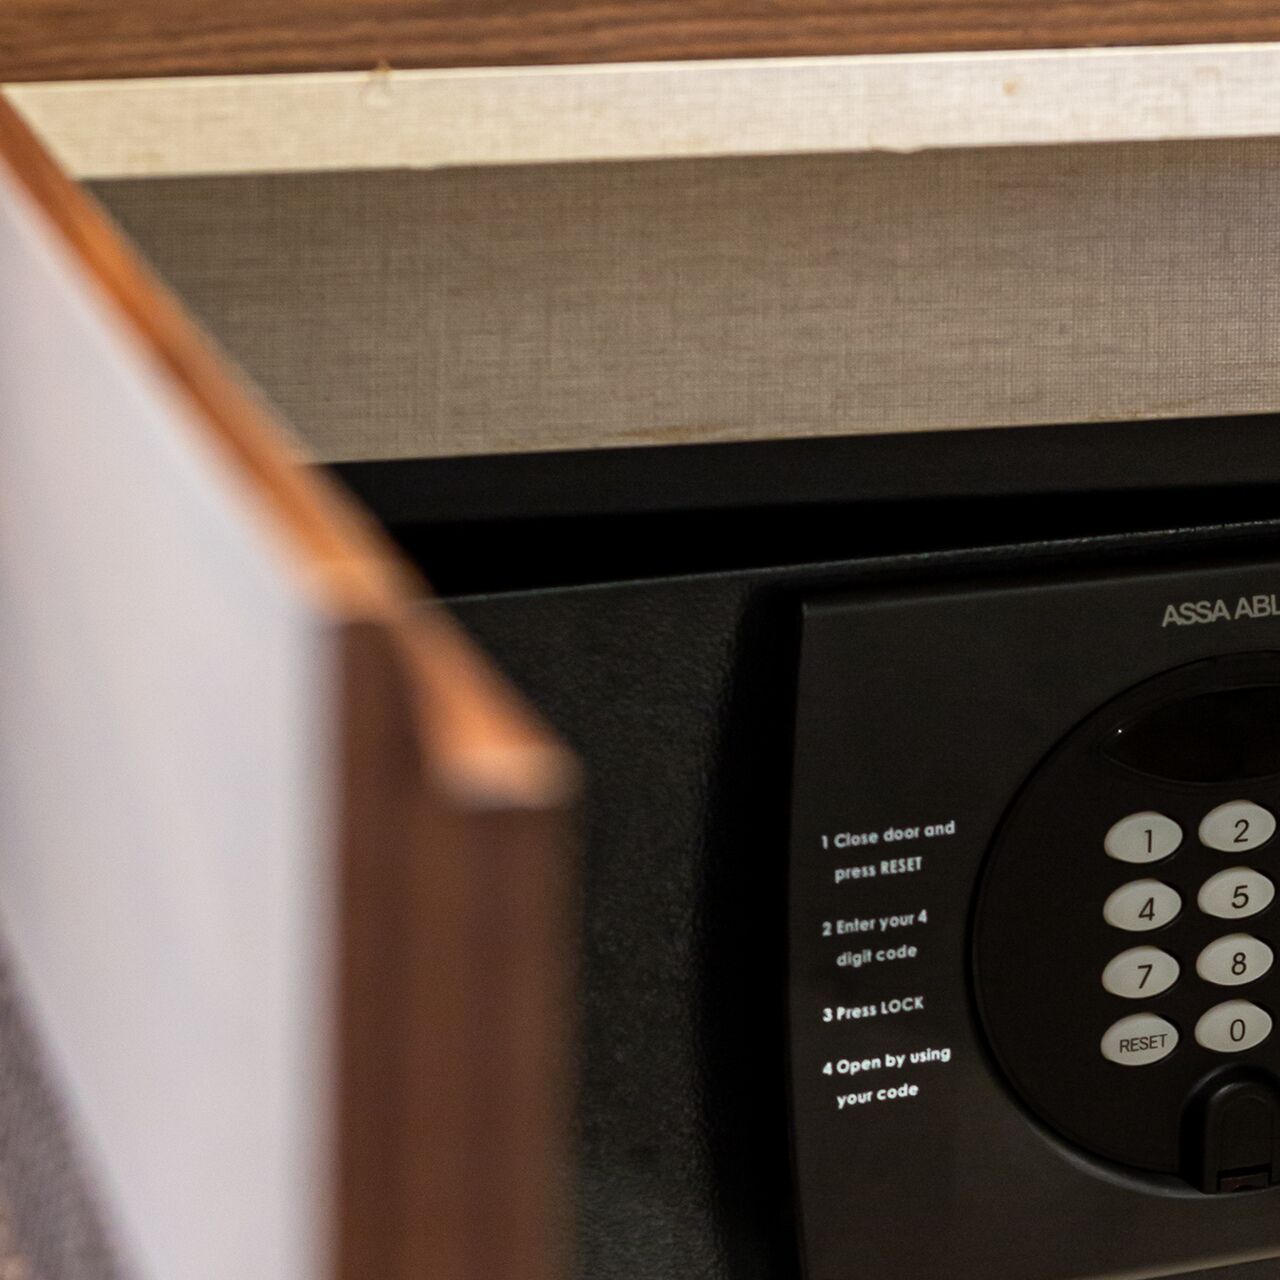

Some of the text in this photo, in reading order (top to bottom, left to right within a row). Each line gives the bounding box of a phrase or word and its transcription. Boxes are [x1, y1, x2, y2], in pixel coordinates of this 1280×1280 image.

[1161, 599, 1232, 628] ASSA
[821, 820, 956, 849] 1 Close door and
[1144, 829, 1153, 854] 1
[1233, 818, 1250, 844] 2
[834, 856, 922, 884] press RESET
[1138, 896, 1156, 921] 4
[1231, 884, 1250, 910] 5
[822, 909, 928, 937] 2 Enter your 4
[836, 944, 918, 968] digit code
[1231, 951, 1247, 976] 8
[1137, 963, 1153, 990] 7
[822, 996, 924, 1023] 3 Press LOCK
[1229, 1018, 1246, 1042] 0
[1119, 1033, 1168, 1054] RESET
[822, 1047, 951, 1076] 4 Open by using
[836, 1083, 919, 1110] your code
